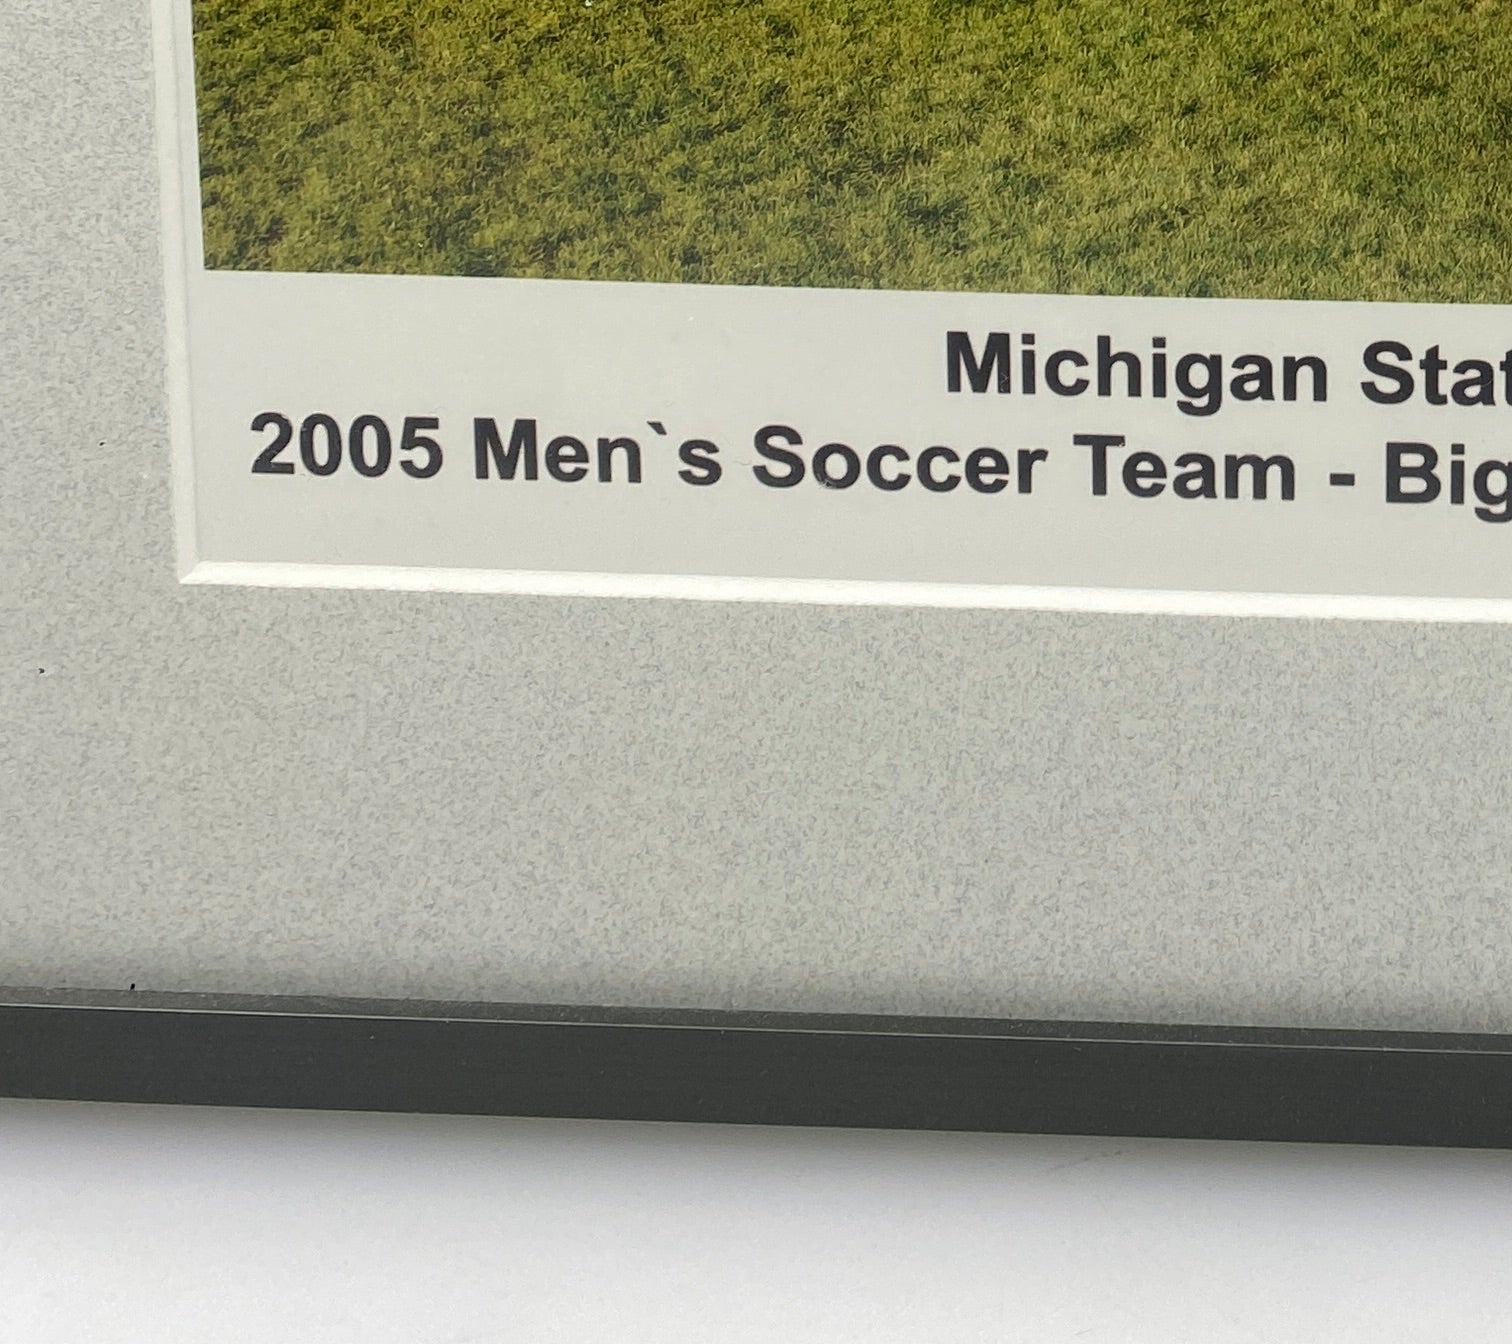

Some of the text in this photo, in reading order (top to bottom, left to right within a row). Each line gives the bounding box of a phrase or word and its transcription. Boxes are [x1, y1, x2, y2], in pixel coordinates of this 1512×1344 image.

[946, 330, 1328, 417] Michigan
[250, 412, 443, 479] 2005
[752, 424, 1049, 494] Soccer
[1073, 434, 1295, 501] Team
[1329, 472, 1356, 487] -
